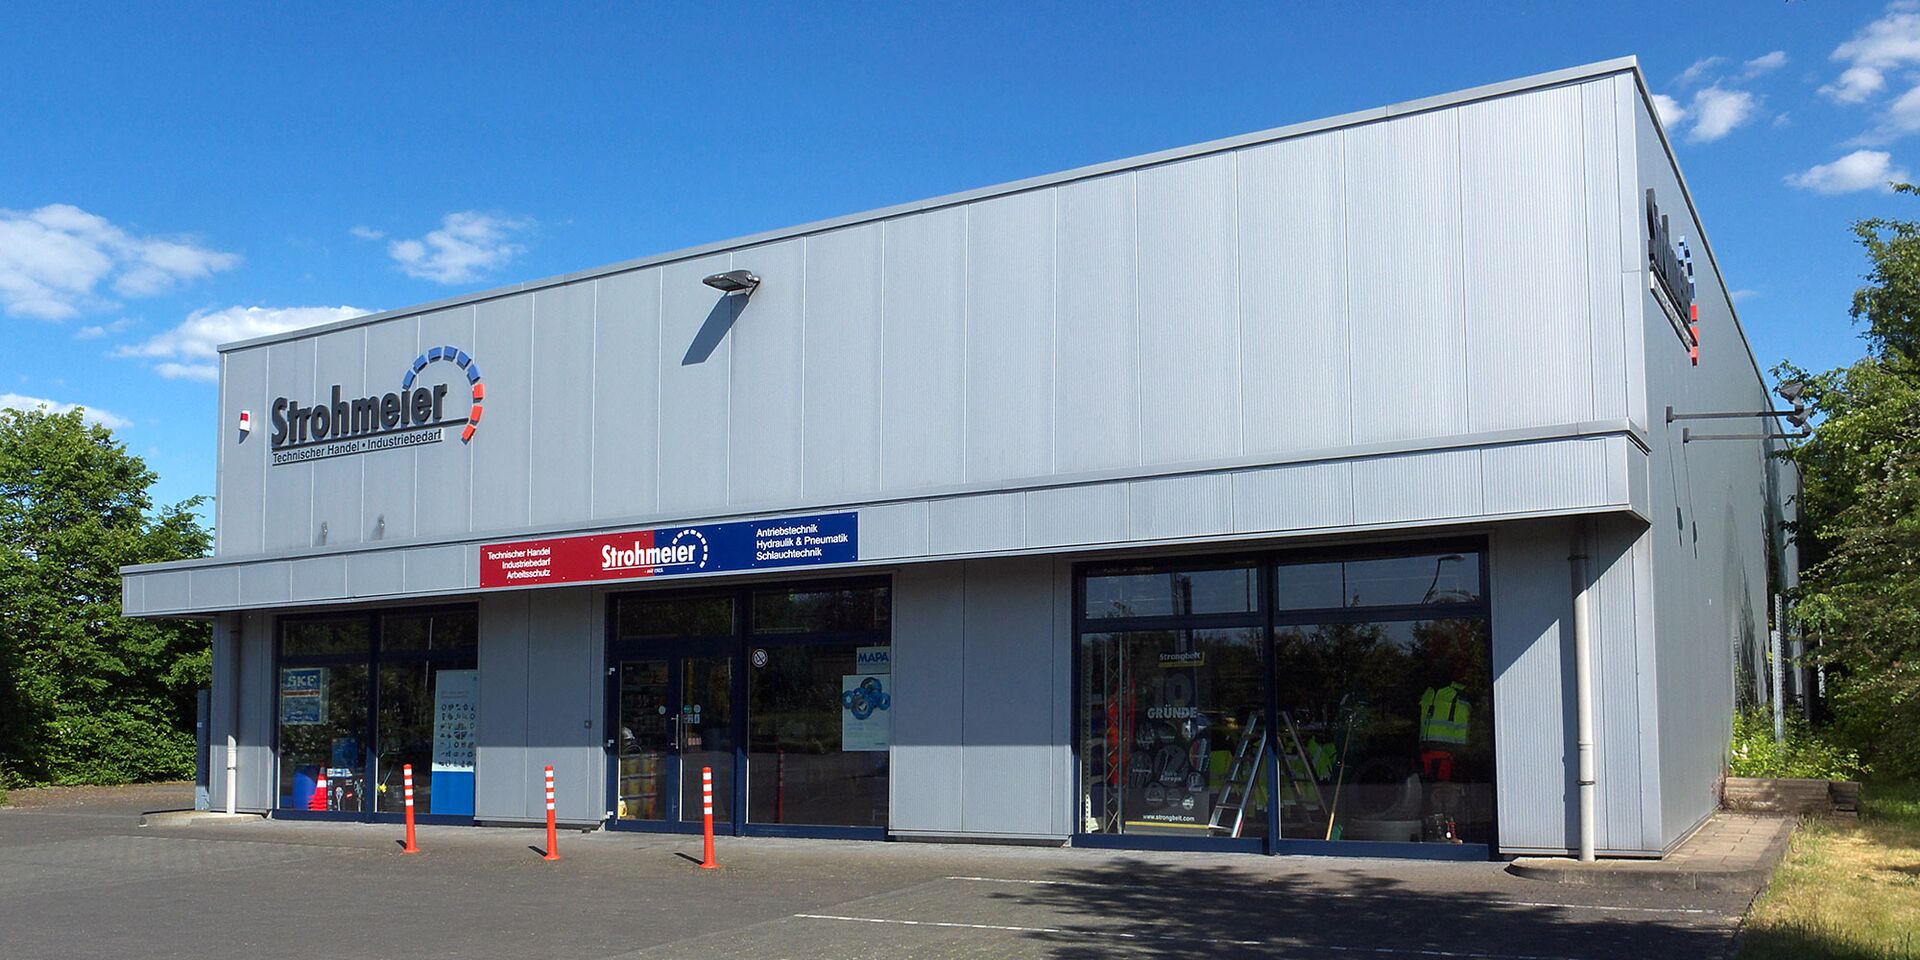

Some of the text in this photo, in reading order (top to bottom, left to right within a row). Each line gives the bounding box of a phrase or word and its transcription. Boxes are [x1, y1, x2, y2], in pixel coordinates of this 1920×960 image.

[272, 383, 447, 445] Strohmeier
[273, 428, 442, 463] Technischer Handel Industriebedarf
[756, 524, 818, 537] Antriebstechnik
[756, 534, 849, 549] Hydraulik & Pneumatik
[487, 547, 551, 560] Technischer Handel
[602, 541, 696, 568] Strohmeier
[756, 547, 822, 560] Schlauchtechnik
[502, 557, 551, 569] Industriebedarf
[506, 569, 551, 579] Arbeitsschutz
[858, 652, 889, 663] MAPA
[1159, 651, 1201, 661] Strongbelt
[287, 675, 317, 687] SKF
[1147, 704, 1197, 719] GRÜNDE
[1142, 813, 1195, 822] www.strongbelt.com
